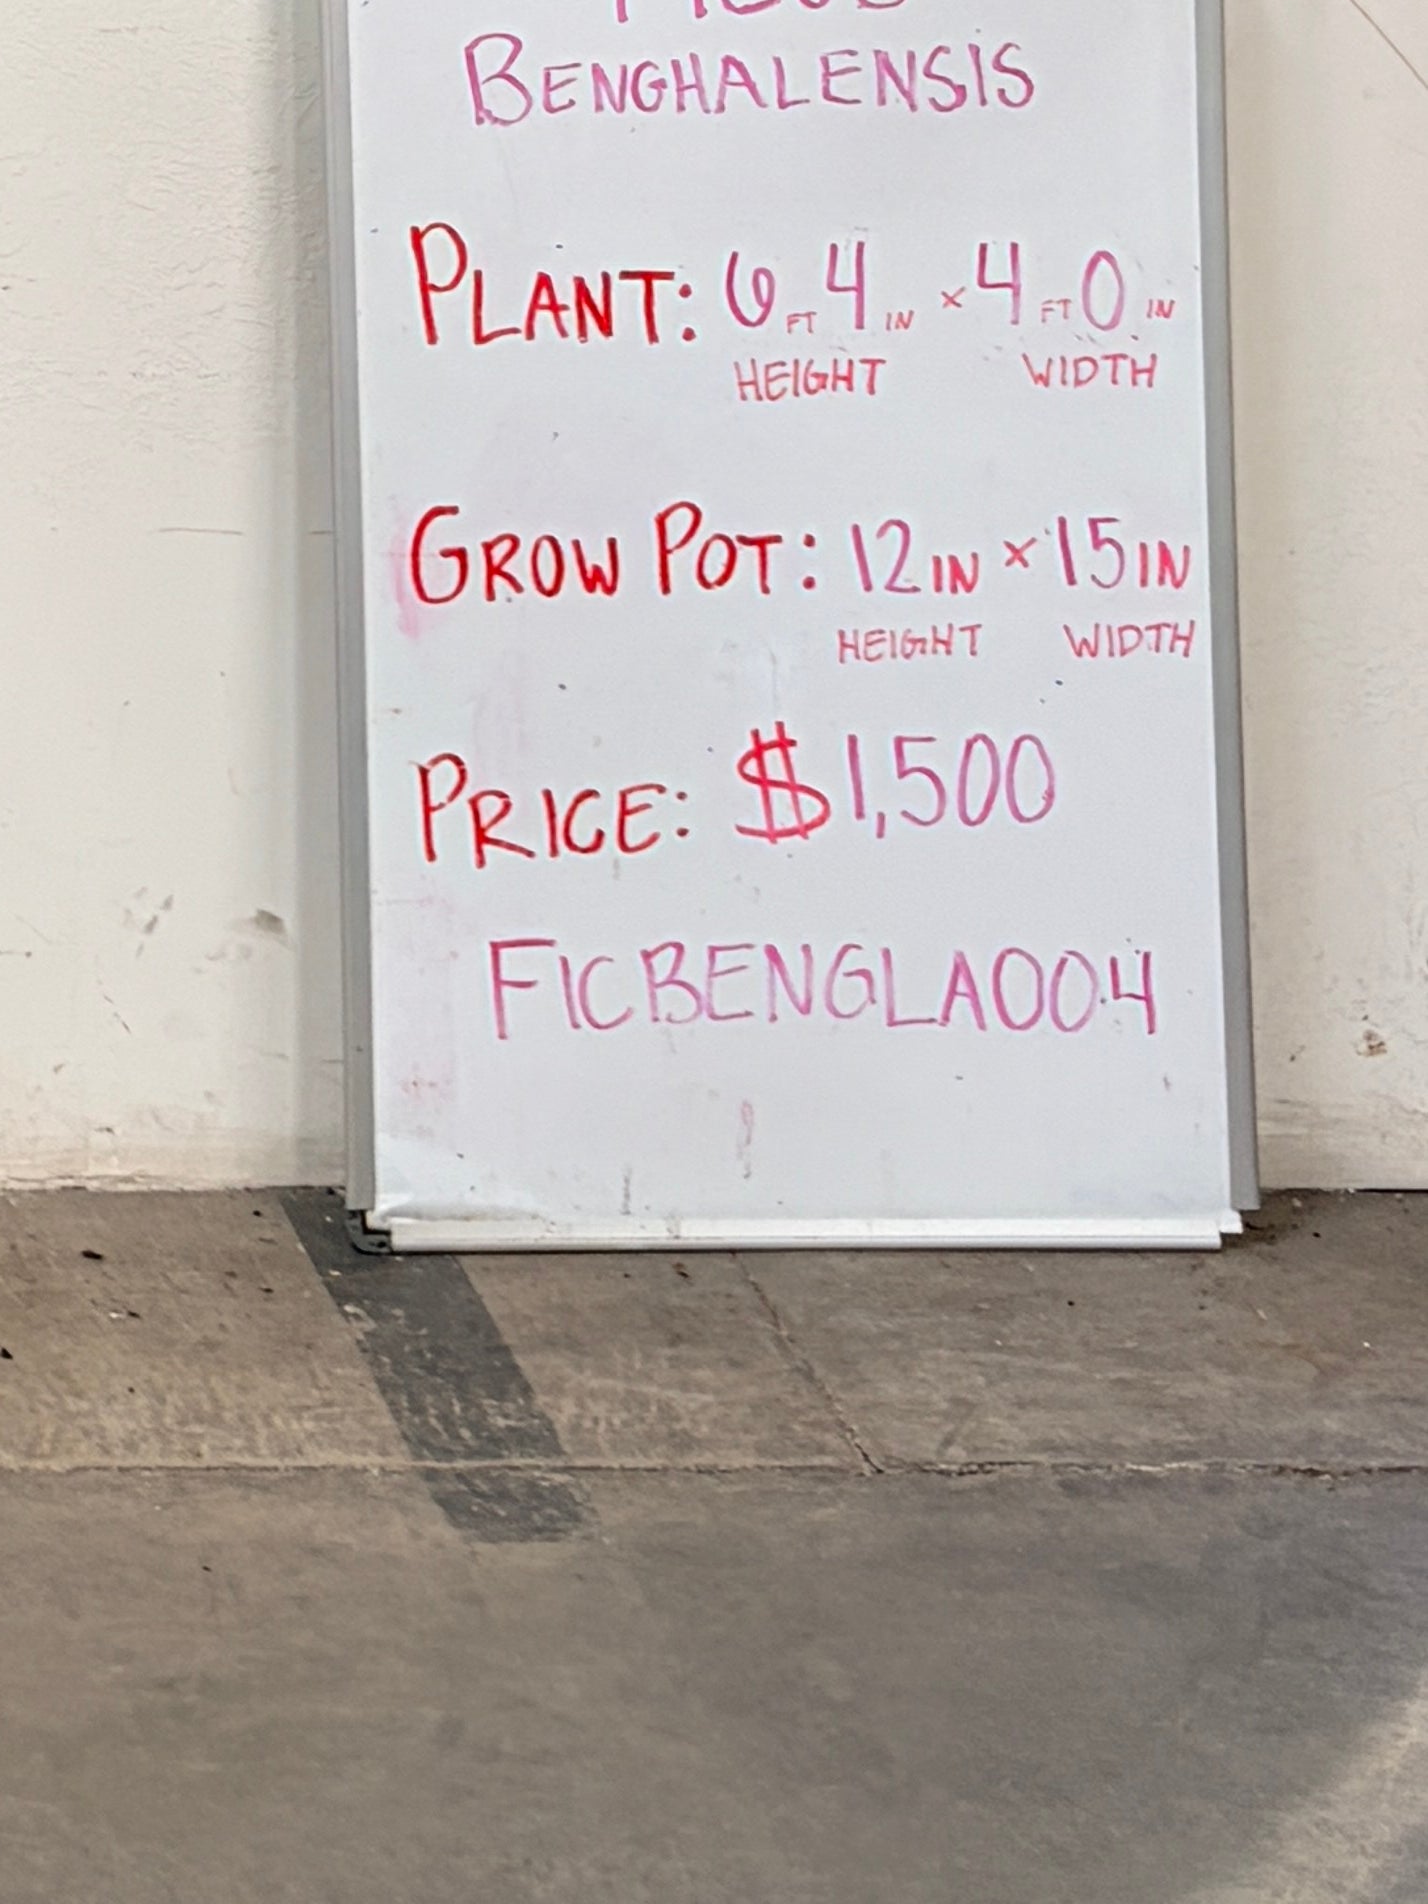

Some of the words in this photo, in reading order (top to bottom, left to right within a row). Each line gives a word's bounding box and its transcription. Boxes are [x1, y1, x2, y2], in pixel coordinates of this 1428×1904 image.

[463, 33, 1035, 126] BENGHALENSIS
[409, 223, 697, 346] PLANT:
[826, 241, 865, 331] 4
[977, 242, 1021, 325] 4
[735, 357, 886, 400] HEIGHT
[1022, 353, 1157, 388] WIDTH
[409, 505, 620, 605] GROW
[654, 501, 817, 595] POT:
[837, 624, 982, 664] HEIGHT
[1064, 621, 1196, 659] WIDTH
[417, 753, 688, 868] PRICE:
[735, 721, 1056, 843] $1,500
[488, 938, 1156, 1039] FICBENGLA004
